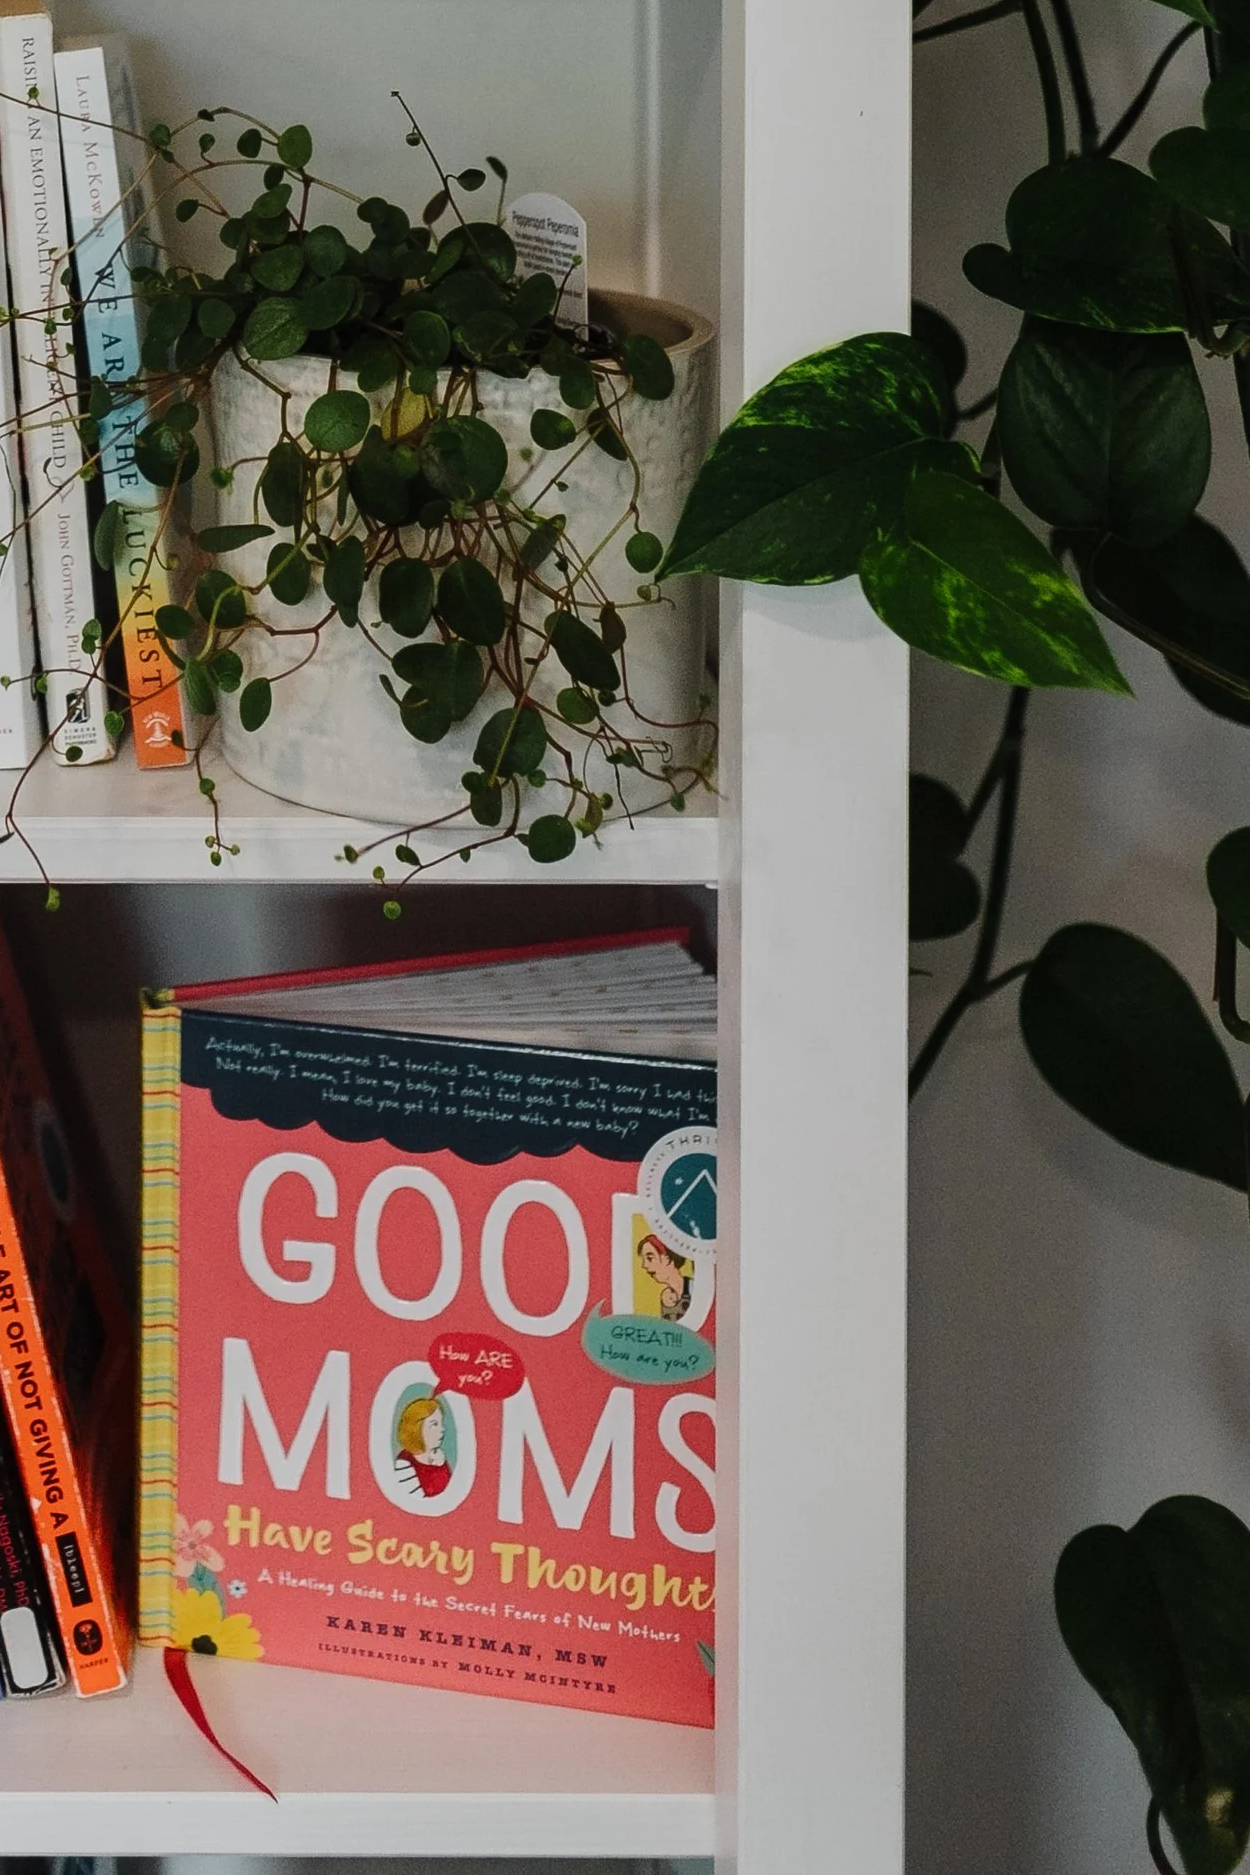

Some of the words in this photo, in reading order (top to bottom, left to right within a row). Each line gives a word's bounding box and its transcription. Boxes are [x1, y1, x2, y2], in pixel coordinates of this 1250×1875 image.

[6, 1320, 29, 1355] OF
[438, 1344, 471, 1364] How
[474, 1348, 513, 1369] ARE
[14, 1361, 43, 1411] NOT
[458, 1370, 494, 1389] you?
[29, 1419, 64, 1504] GIVING
[218, 1337, 716, 1553] MOMS
[50, 1510, 70, 1530] A
[223, 1504, 332, 1556] Have
[347, 1519, 475, 1585] Scary
[257, 1568, 273, 1586] A
[278, 1570, 336, 1597] Healing
[340, 1579, 386, 1602] Guide
[390, 1587, 408, 1604] to
[413, 1590, 439, 1611] the
[445, 1595, 497, 1617] Secret
[503, 1603, 547, 1625] Fears
[553, 1609, 572, 1629] of
[577, 1613, 611, 1633] New
[618, 1620, 681, 1643] Mothers
[325, 1614, 408, 1640] KAREN
[419, 1625, 544, 1663] KLEIMAN,
[555, 1648, 609, 1669] MSW
